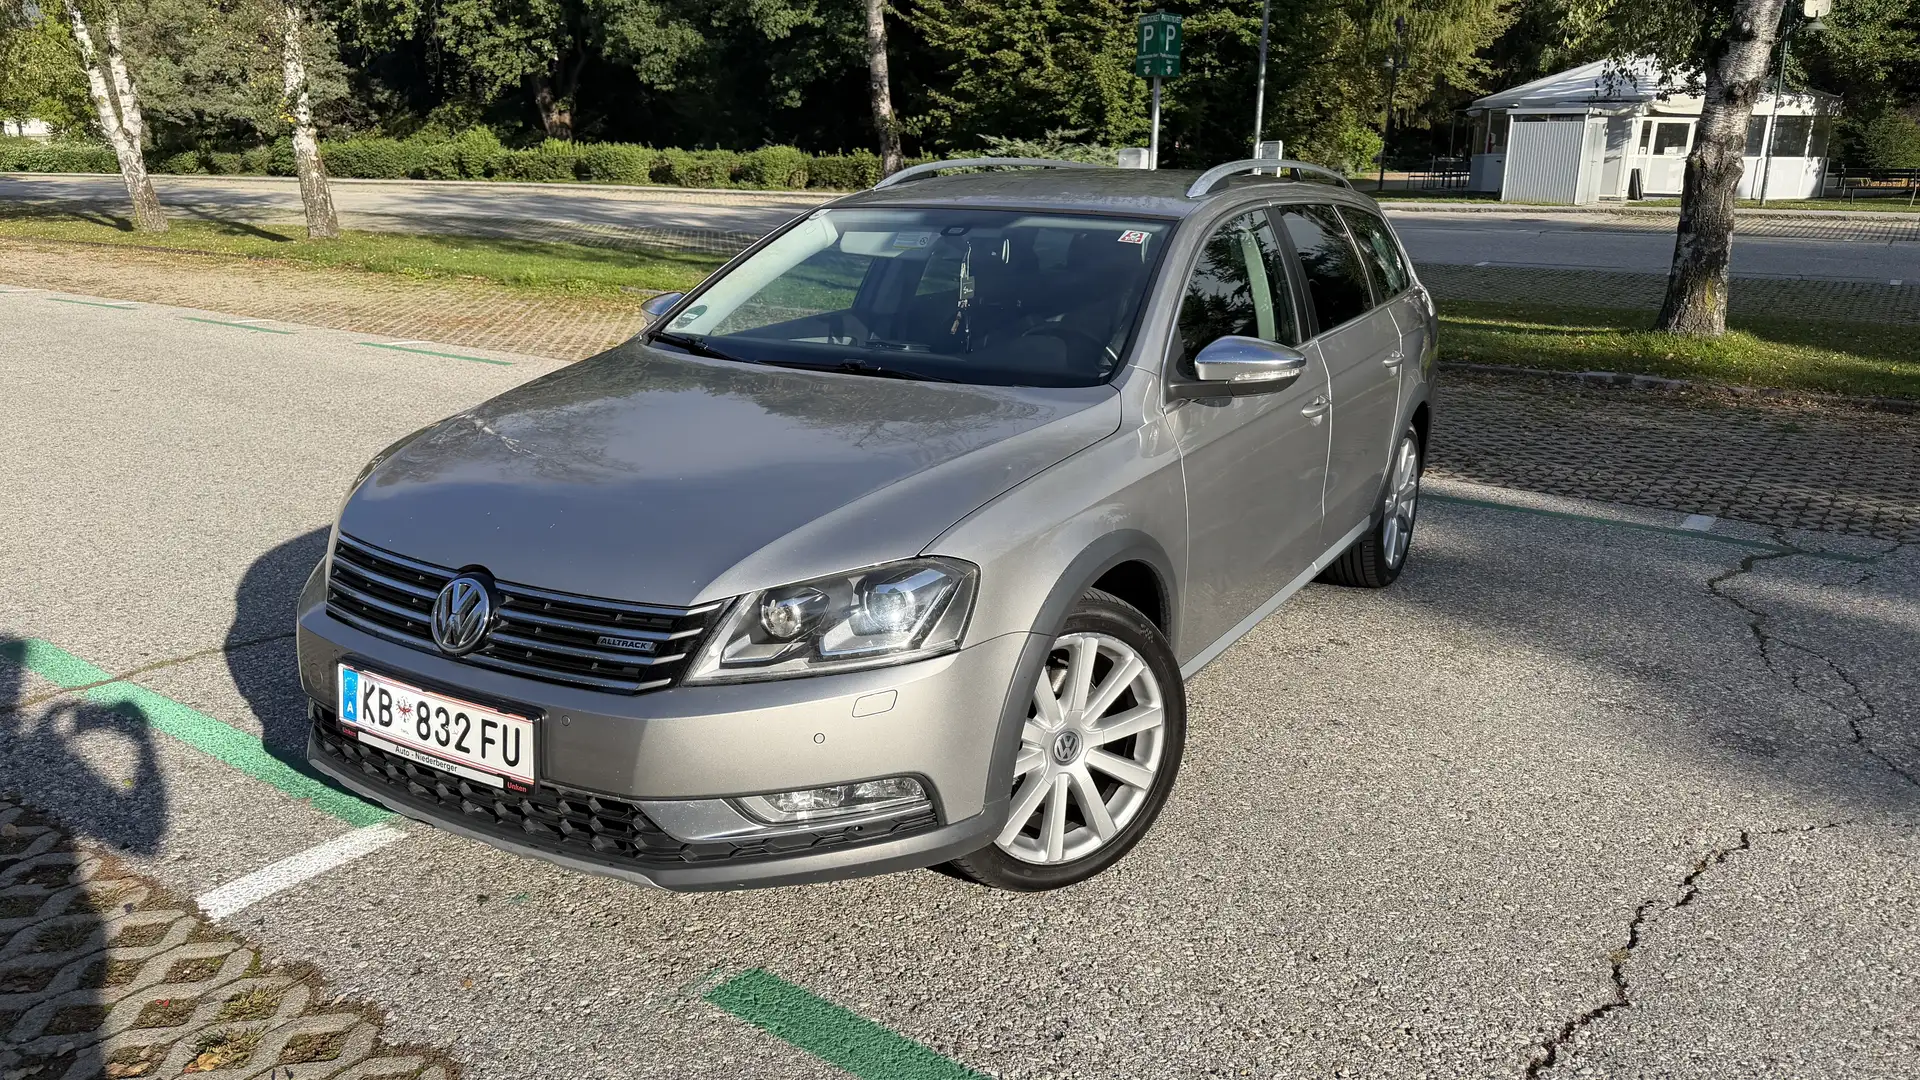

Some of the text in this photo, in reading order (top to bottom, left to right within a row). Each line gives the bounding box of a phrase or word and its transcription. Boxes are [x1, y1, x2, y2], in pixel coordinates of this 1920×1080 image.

[1143, 25, 1154, 53] P
[1165, 24, 1176, 52] P
[600, 638, 648, 649] ALLTRACK
[346, 700, 355, 714] A
[362, 680, 520, 767] KB 832 FU
[395, 745, 410, 758] Auto
[415, 752, 458, 773] Niederberger
[507, 781, 527, 793] Unken
